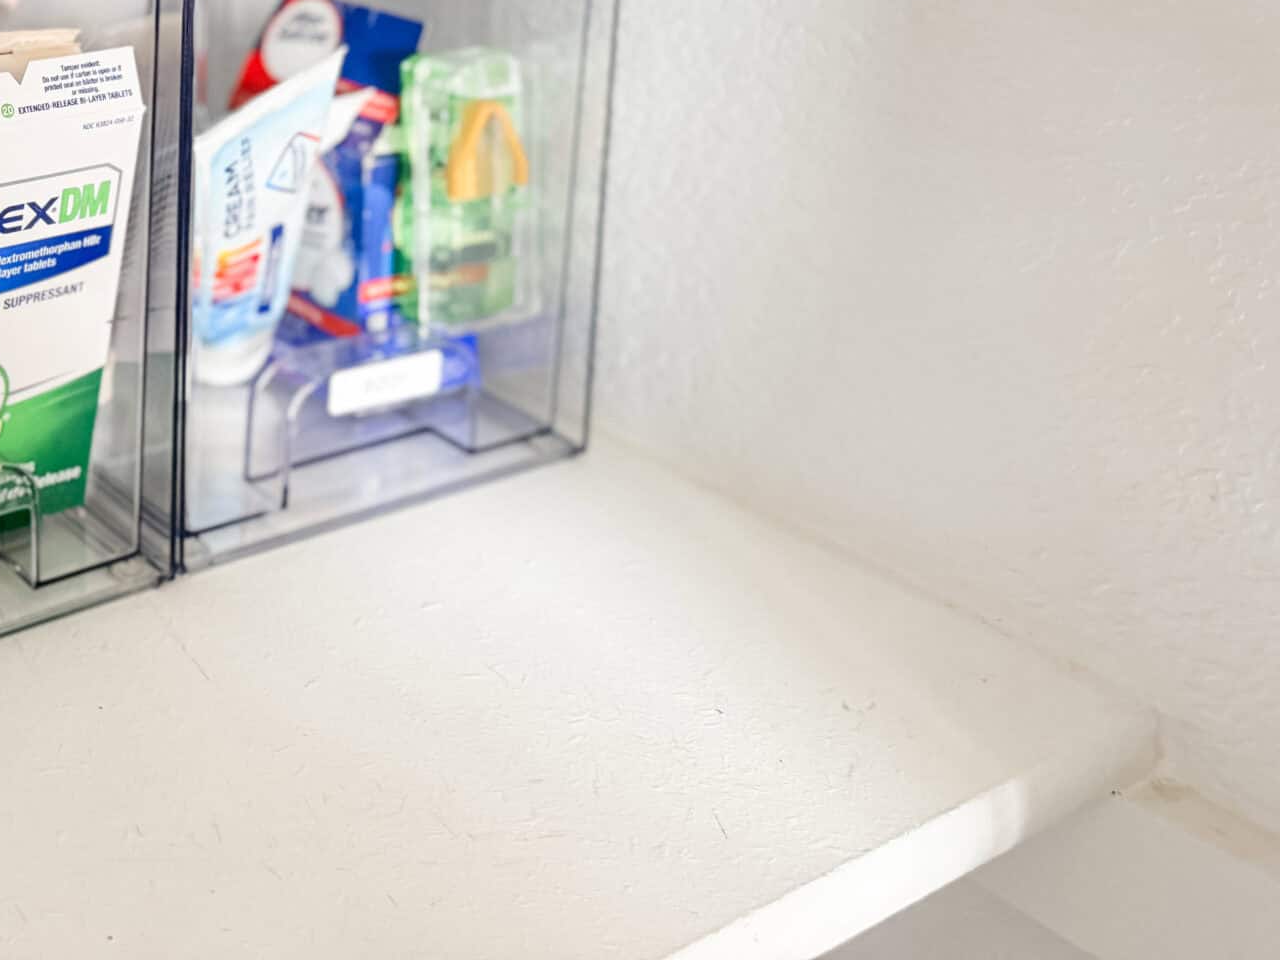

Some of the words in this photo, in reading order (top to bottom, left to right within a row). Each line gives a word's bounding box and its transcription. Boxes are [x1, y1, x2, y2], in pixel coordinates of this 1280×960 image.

[80, 94, 108, 106] BI-LAYER
[108, 88, 134, 100] TABLETS
[23, 257, 57, 274] tablets
[3, 281, 85, 311] SUPPRESSANT
